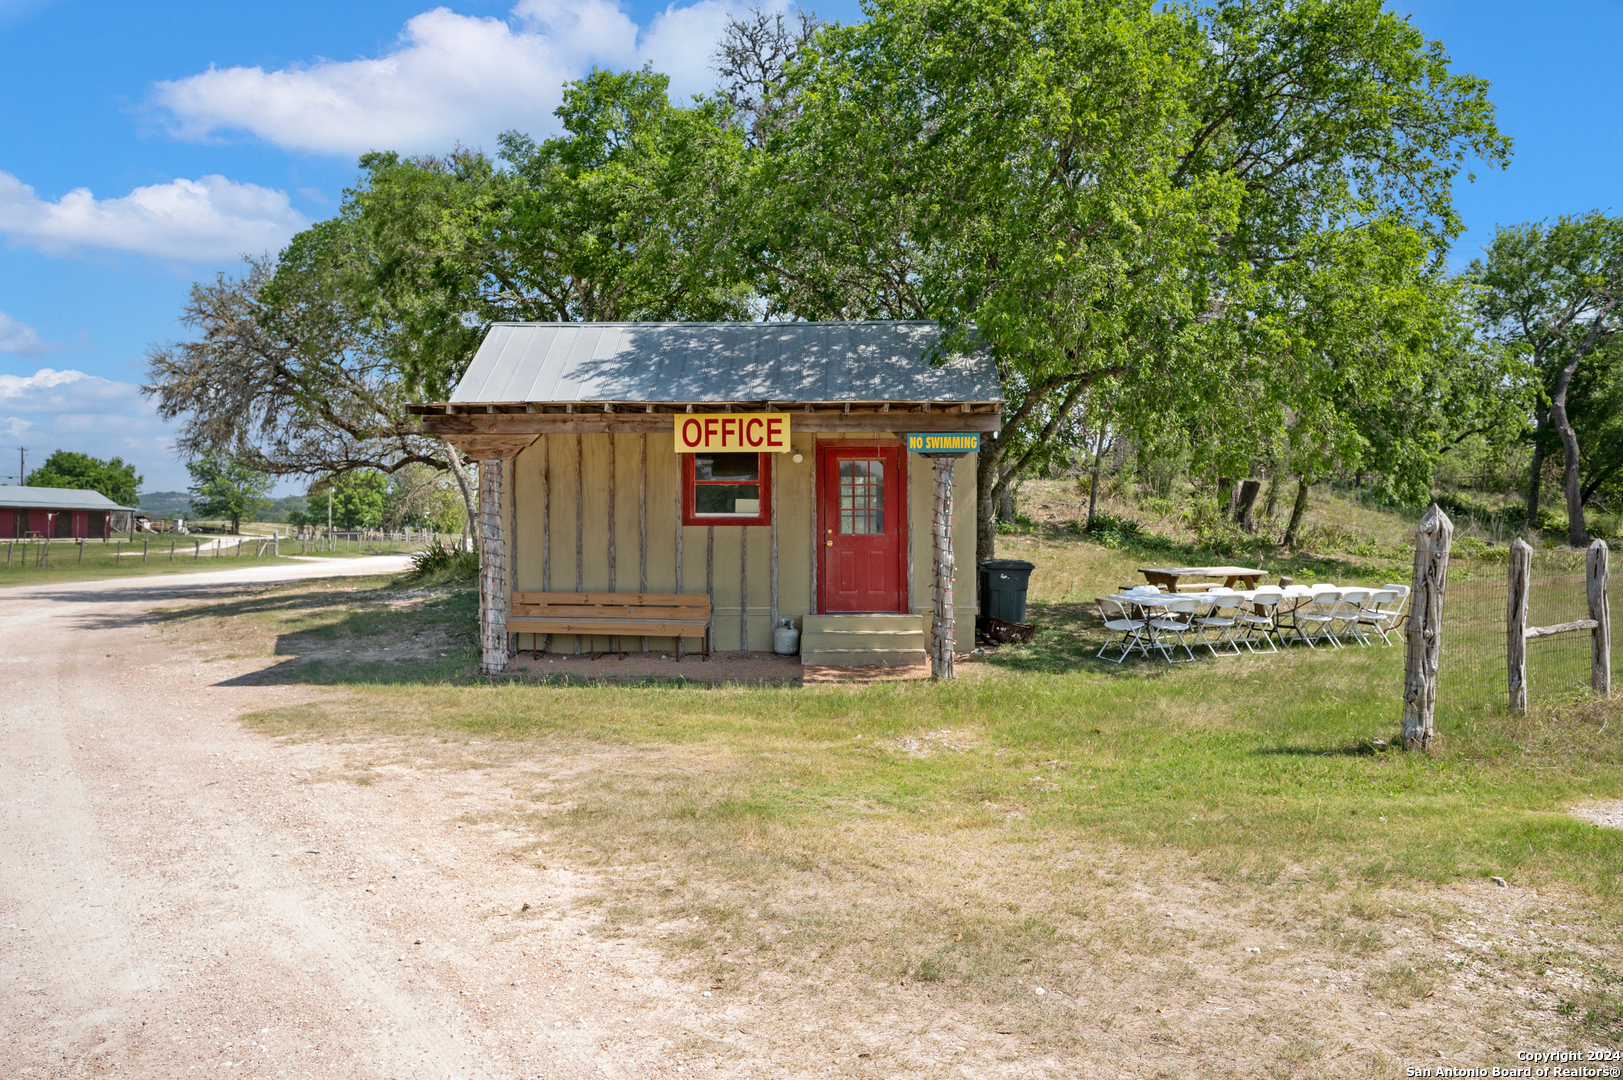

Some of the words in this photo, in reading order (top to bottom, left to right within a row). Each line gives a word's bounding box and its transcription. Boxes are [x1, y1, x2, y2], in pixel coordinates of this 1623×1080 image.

[682, 418, 783, 447] OFFICE
[909, 436, 923, 449] NO
[926, 436, 977, 449] SWIMMING
